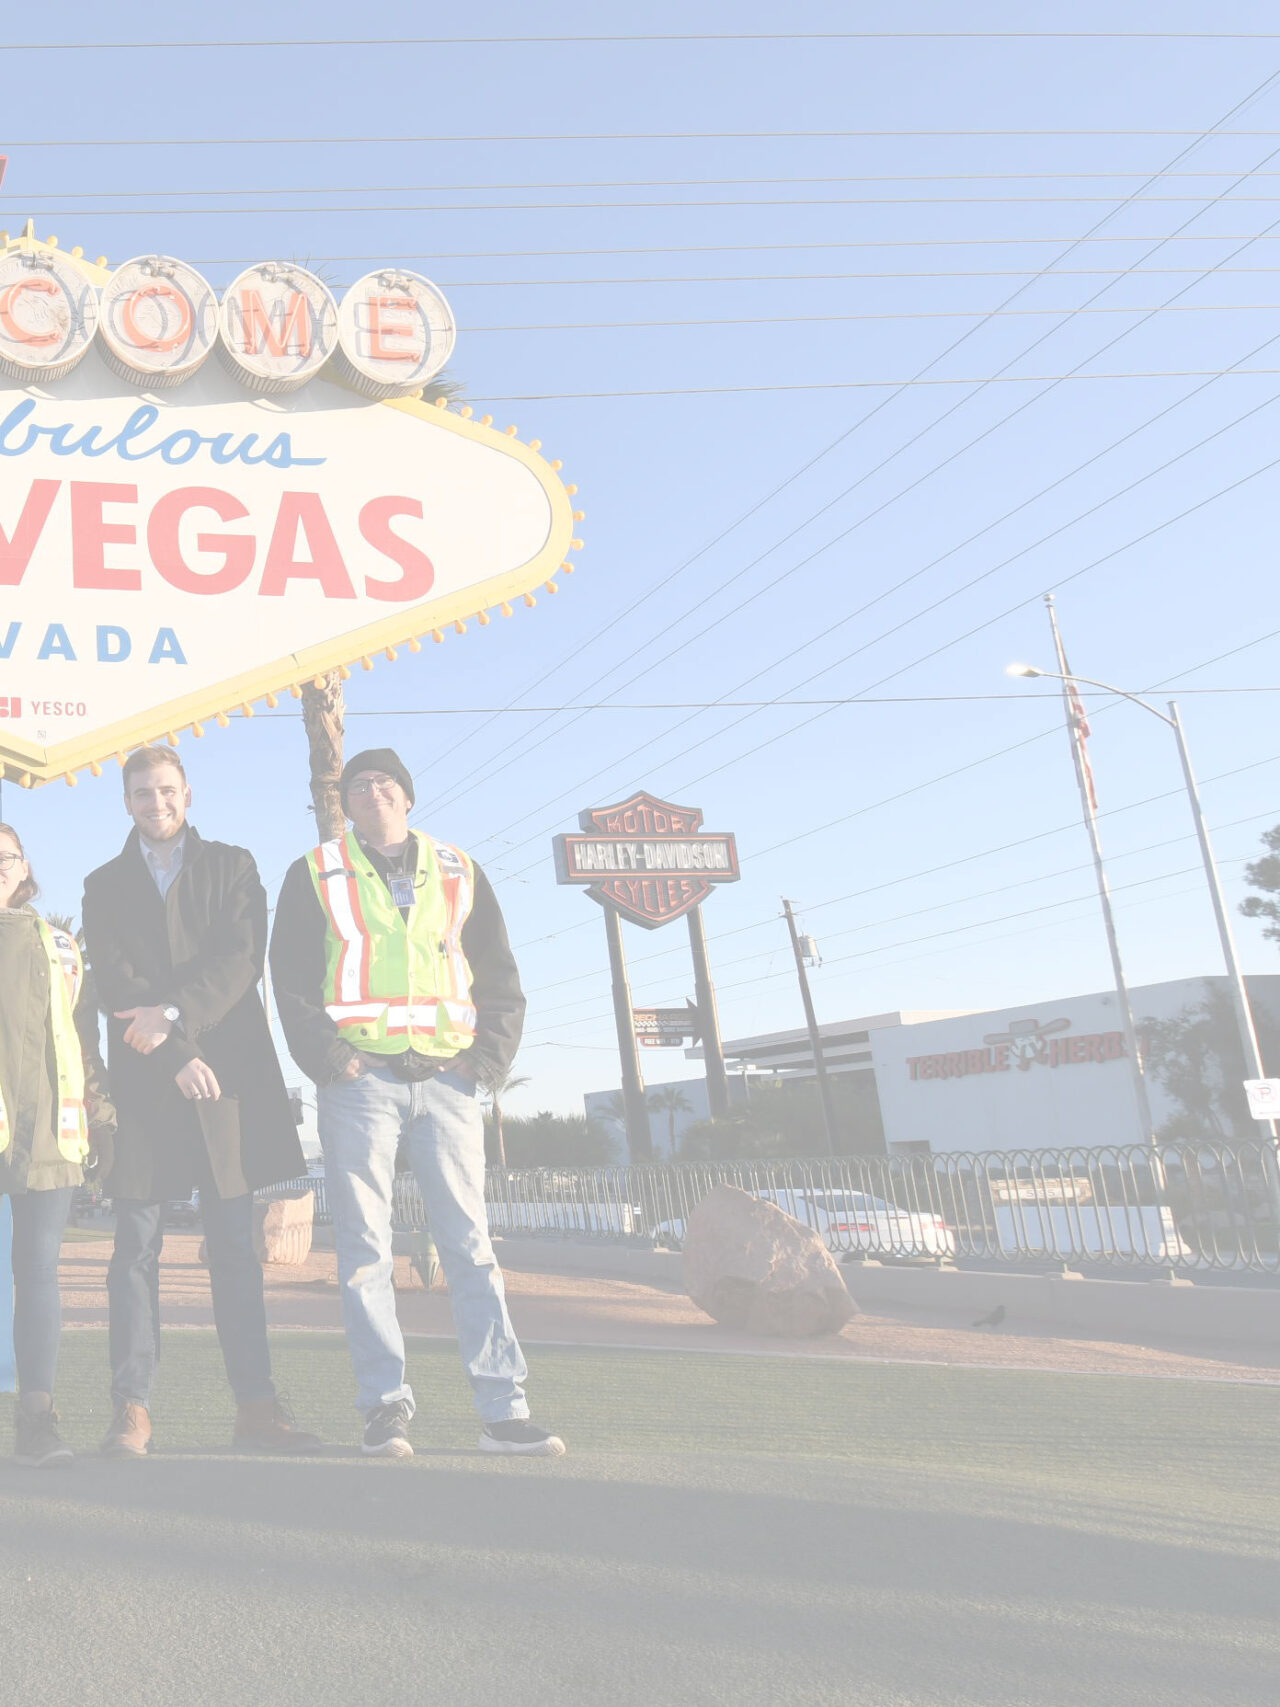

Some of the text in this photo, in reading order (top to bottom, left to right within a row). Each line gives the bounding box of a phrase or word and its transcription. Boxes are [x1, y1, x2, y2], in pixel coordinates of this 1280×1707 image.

[31, 700, 87, 717] YESCO
[606, 803, 686, 833] MOTOR
[573, 842, 729, 870] HARLEY-DAVIDSON
[613, 880, 695, 914] CYCLES
[906, 1030, 1149, 1081] TERRIBLE HERB
